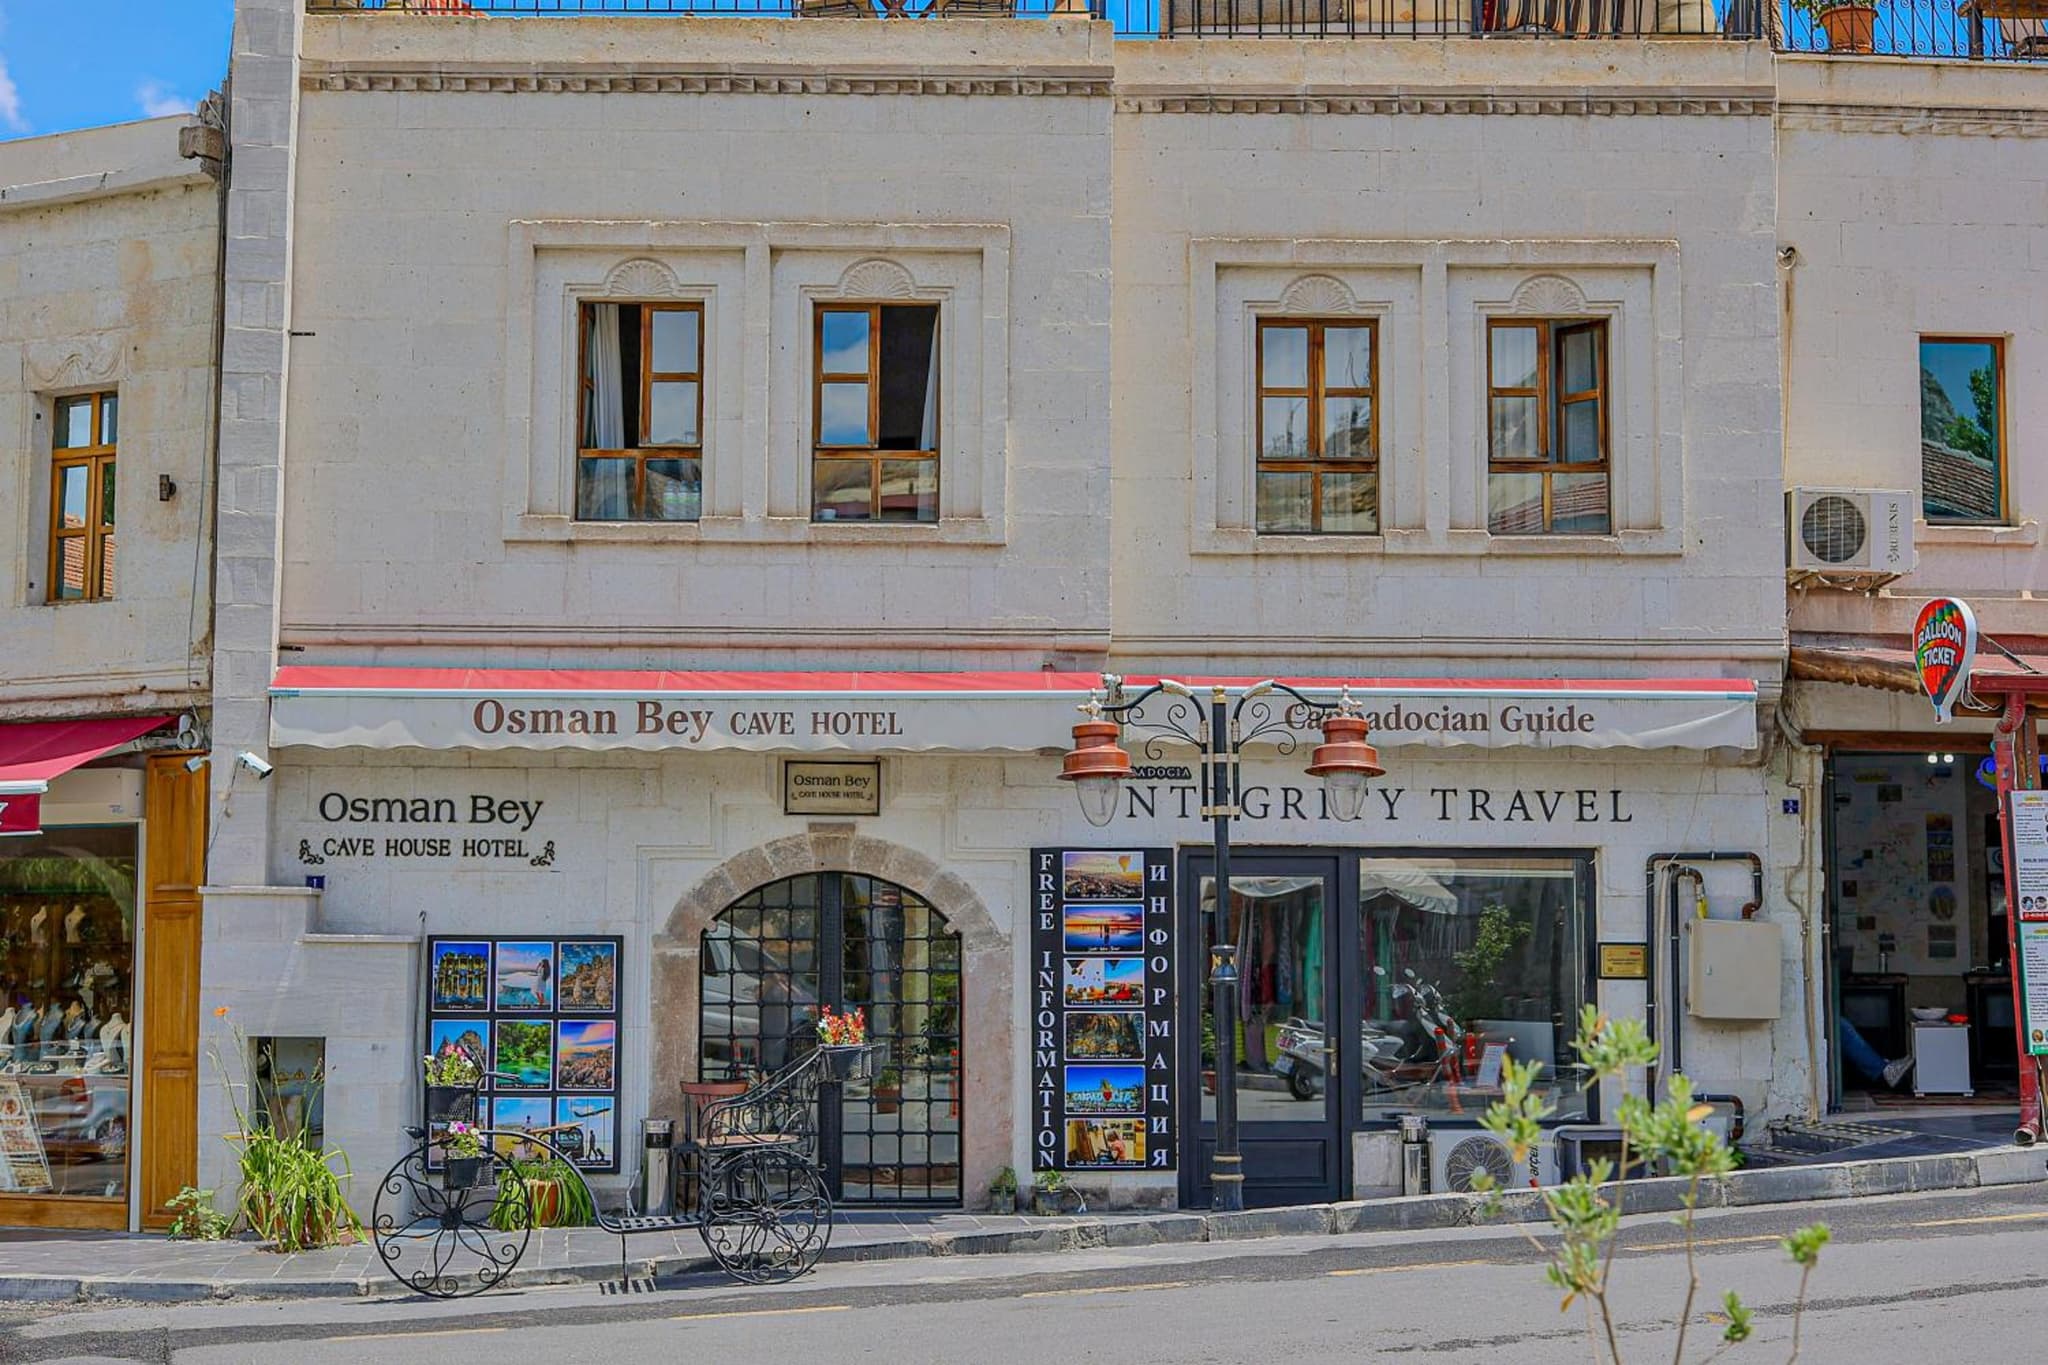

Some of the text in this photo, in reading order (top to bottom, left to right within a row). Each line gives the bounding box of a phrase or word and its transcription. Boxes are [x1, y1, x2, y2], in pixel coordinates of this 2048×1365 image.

[1918, 621, 1962, 647] BALLOON
[1923, 647, 1957, 667] TICKET
[473, 700, 904, 743] Osman Bey CAVE HOTEL
[1500, 704, 1595, 733] Guide
[794, 775, 871, 789] Osman Bey
[318, 793, 544, 833] Osman Bey
[1431, 788, 1633, 823] TRAVEL
[323, 838, 530, 859] CAVE HOUSE HOTEL
[1036, 853, 1057, 1168] FREE INFORMATION
[1148, 864, 1169, 1167] ИНФОРМАЦИЯ
